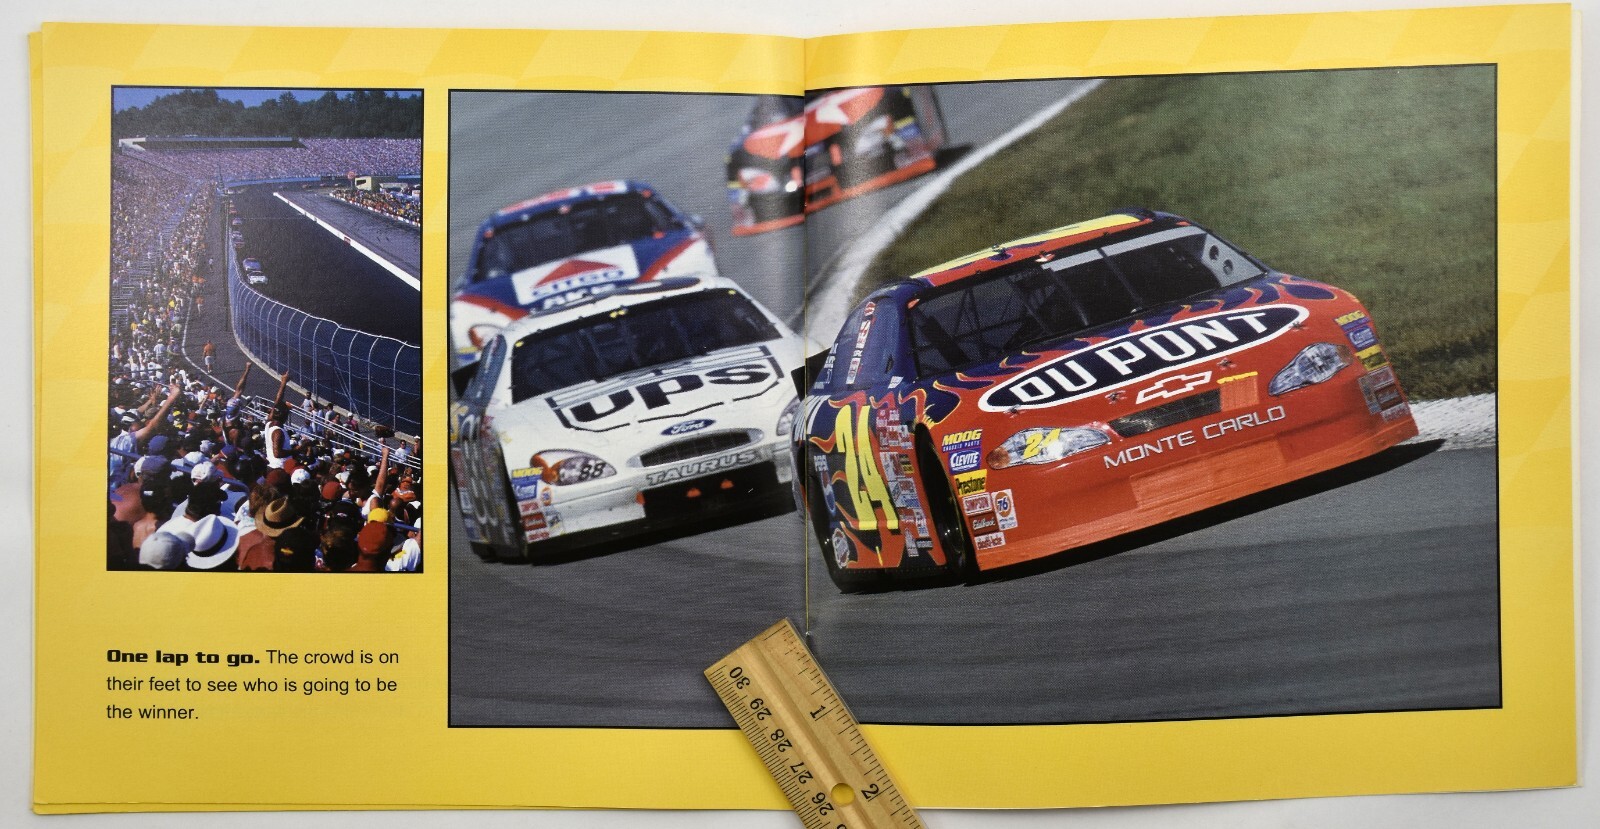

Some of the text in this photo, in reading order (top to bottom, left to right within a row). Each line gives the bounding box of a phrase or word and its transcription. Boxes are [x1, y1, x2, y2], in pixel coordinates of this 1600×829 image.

[1008, 311, 1267, 402] DU PONT
[670, 420, 705, 434] Ford
[942, 429, 984, 447] MOOG
[1103, 405, 1287, 470] MONTE CARLO
[1022, 429, 1061, 459] 24
[578, 462, 608, 481] 88
[645, 448, 760, 486] TAURUS
[834, 404, 900, 531] 24
[997, 497, 1009, 512] 76
[106, 649, 399, 668] One lap to go. The crowd is on
[106, 676, 398, 696] their feet to see who is going to be
[729, 666, 750, 690] 30
[106, 704, 199, 720] the winner.
[750, 697, 772, 721] 29
[809, 704, 826, 719] 1
[770, 728, 793, 753] 28
[790, 761, 813, 785] 27
[861, 782, 880, 800] 2
[811, 792, 835, 816] 26
